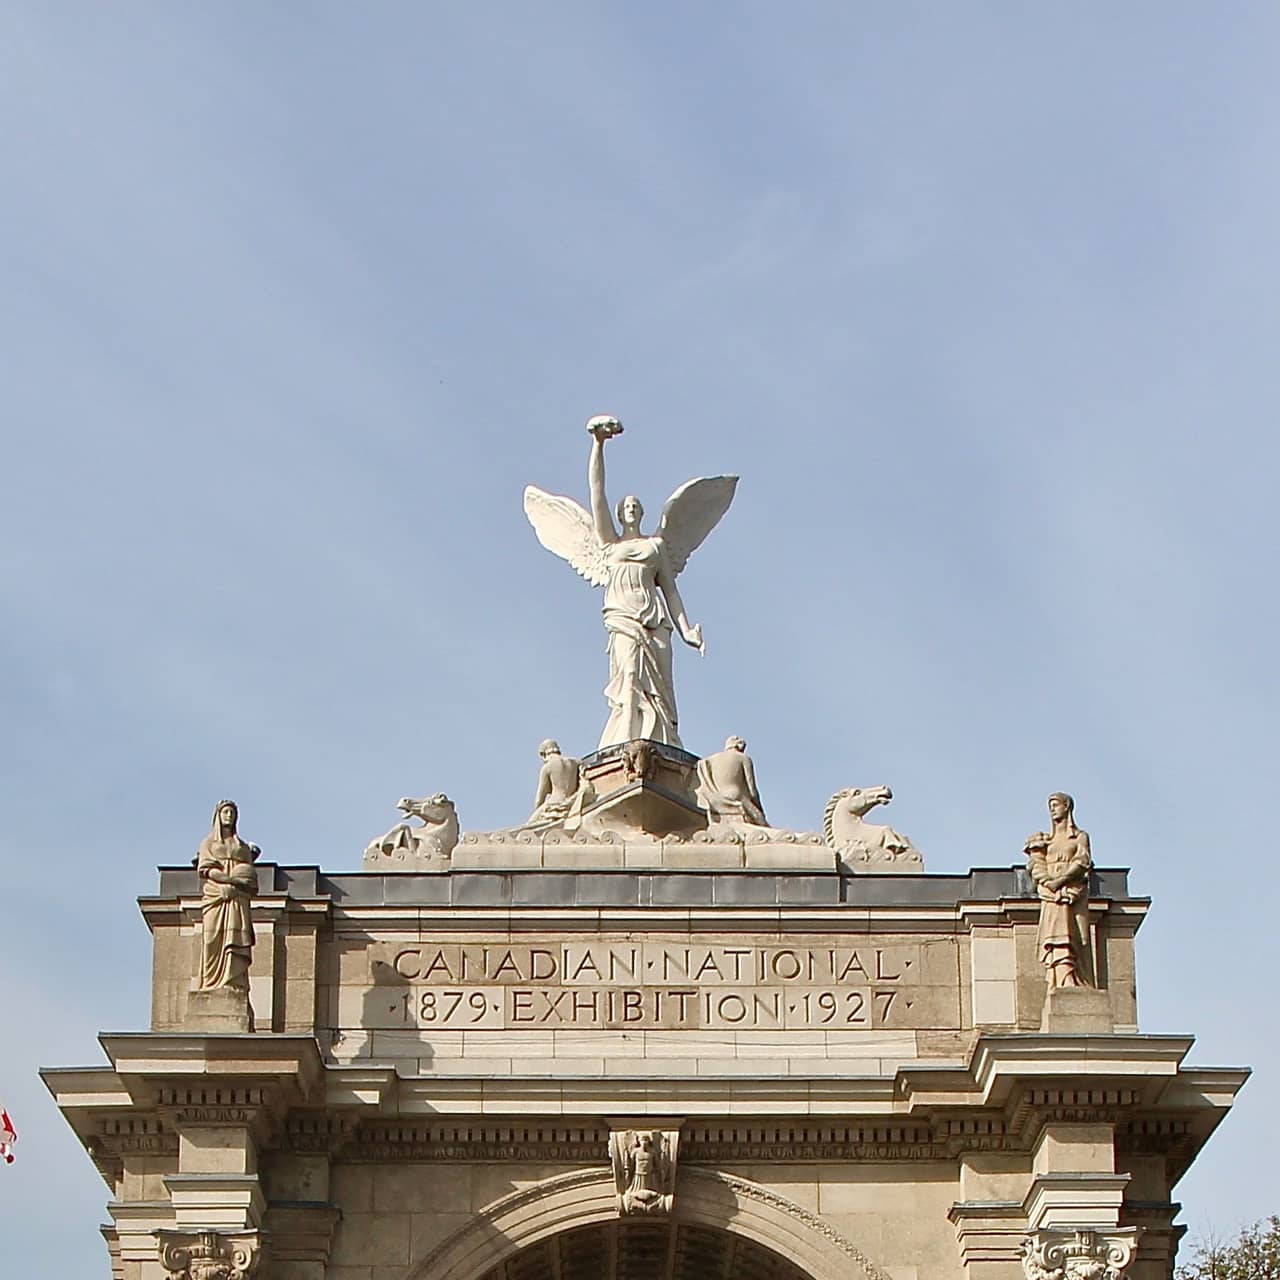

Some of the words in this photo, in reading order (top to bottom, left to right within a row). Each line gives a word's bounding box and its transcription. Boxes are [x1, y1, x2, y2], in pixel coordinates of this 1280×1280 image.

[393, 949, 636, 981] CANADIAN
[664, 949, 901, 981] NATIONAL
[402, 991, 488, 1024] 1879
[511, 990, 782, 1024] EXHIBITION
[802, 991, 898, 1024] 1927
